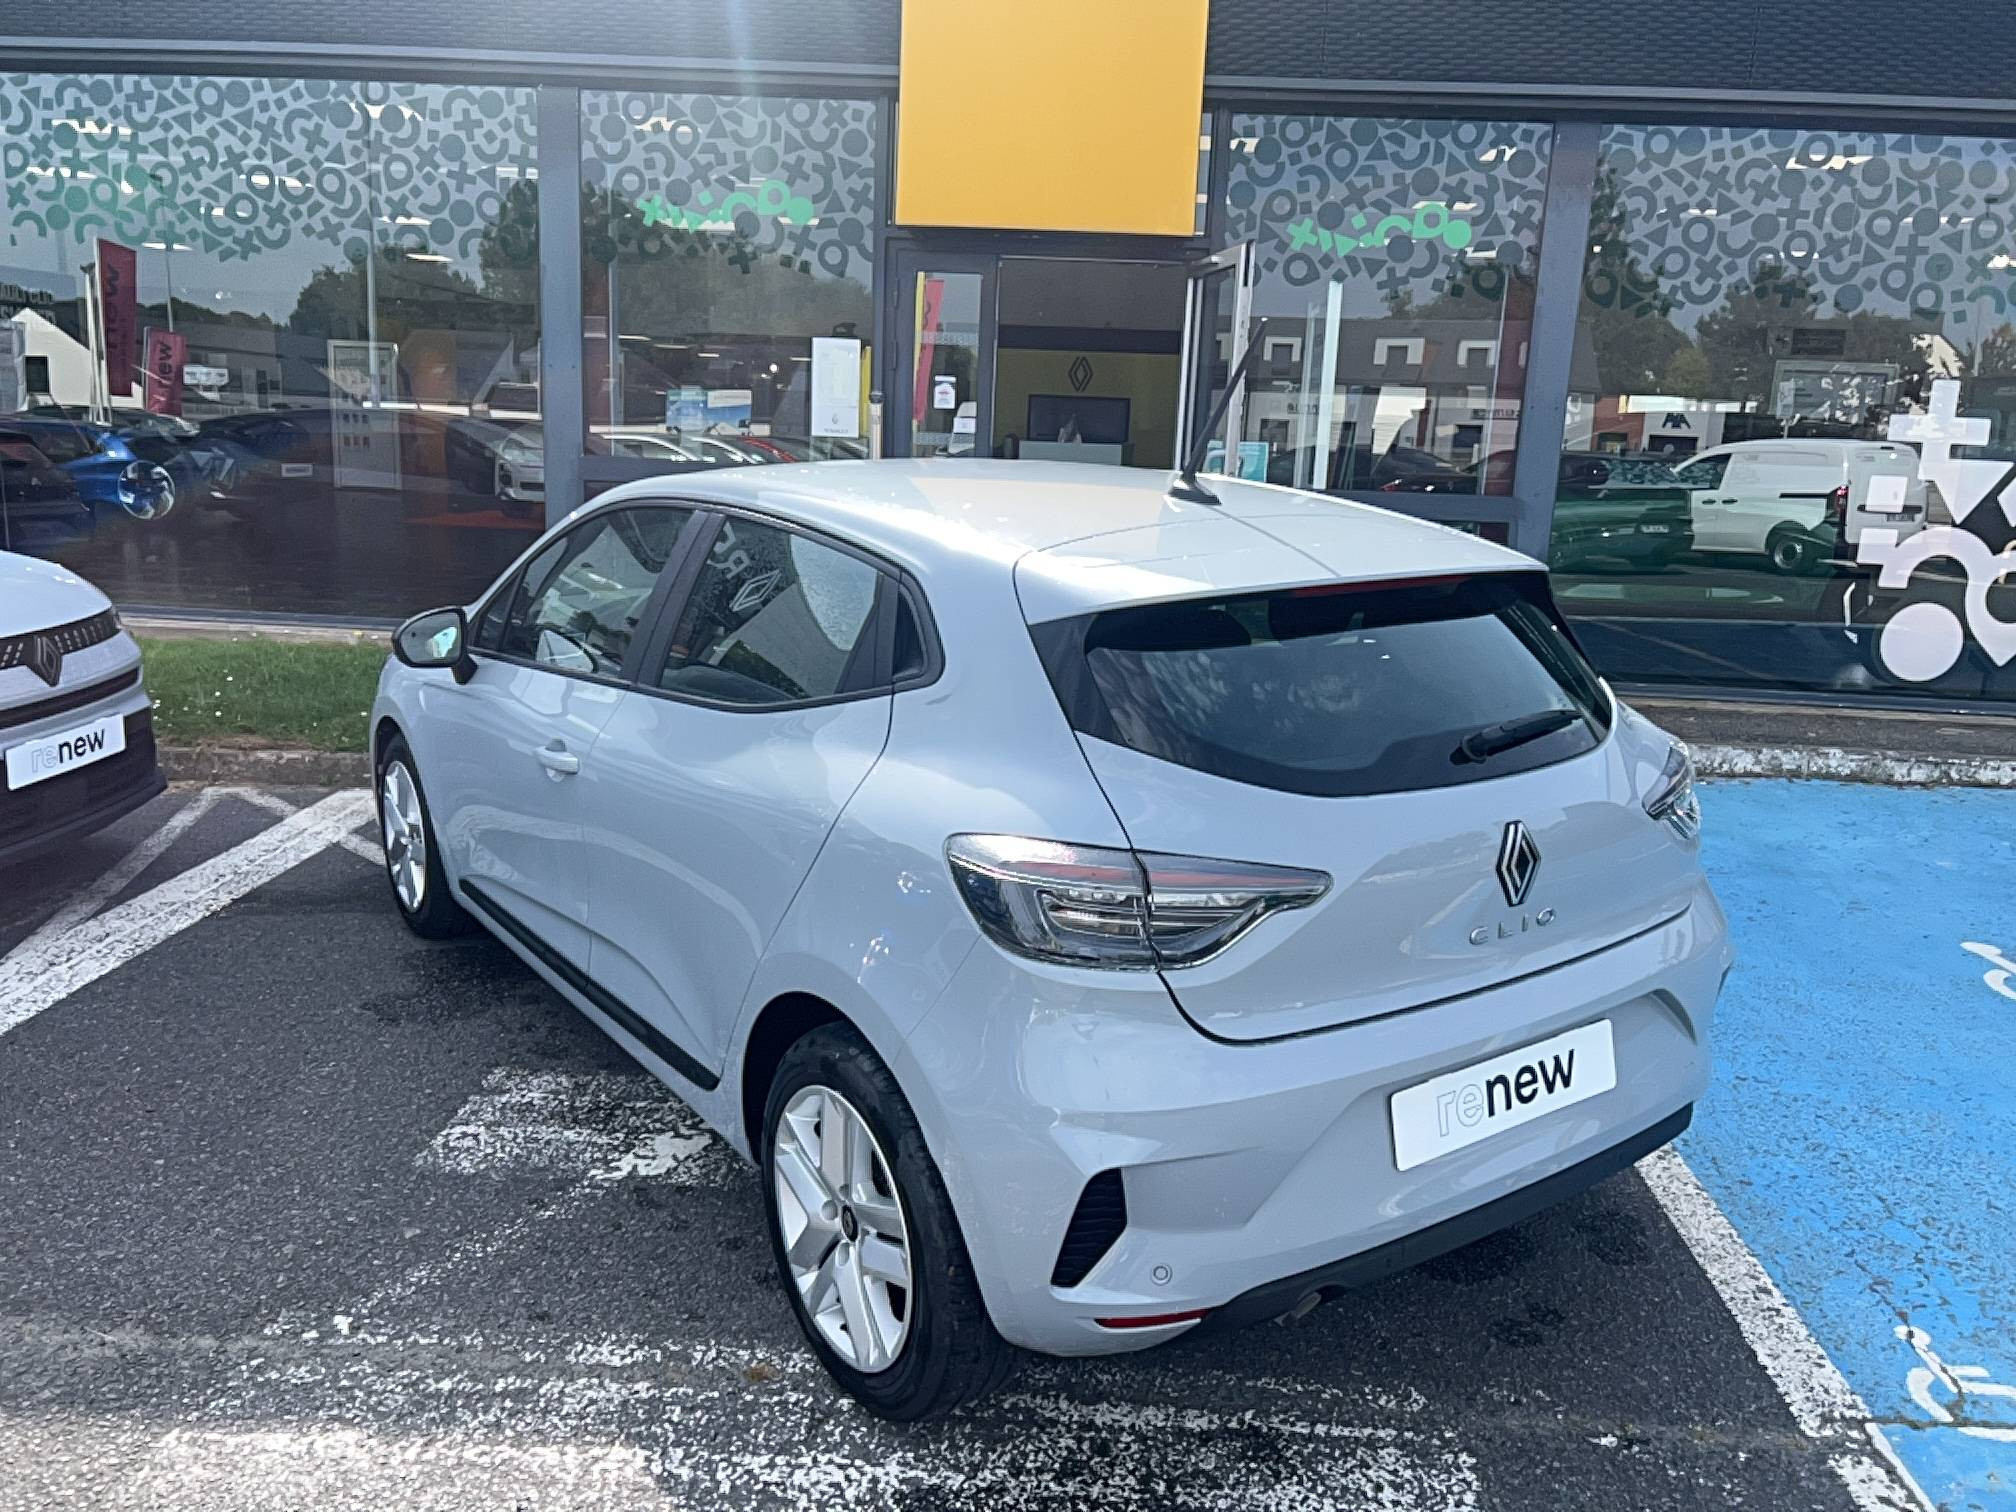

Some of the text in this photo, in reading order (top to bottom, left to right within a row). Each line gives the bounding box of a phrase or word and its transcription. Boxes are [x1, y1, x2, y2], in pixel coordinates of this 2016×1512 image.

[29, 728, 105, 774] renew
[1469, 907, 1556, 945] CLIO
[1436, 1048, 1575, 1137] renew
